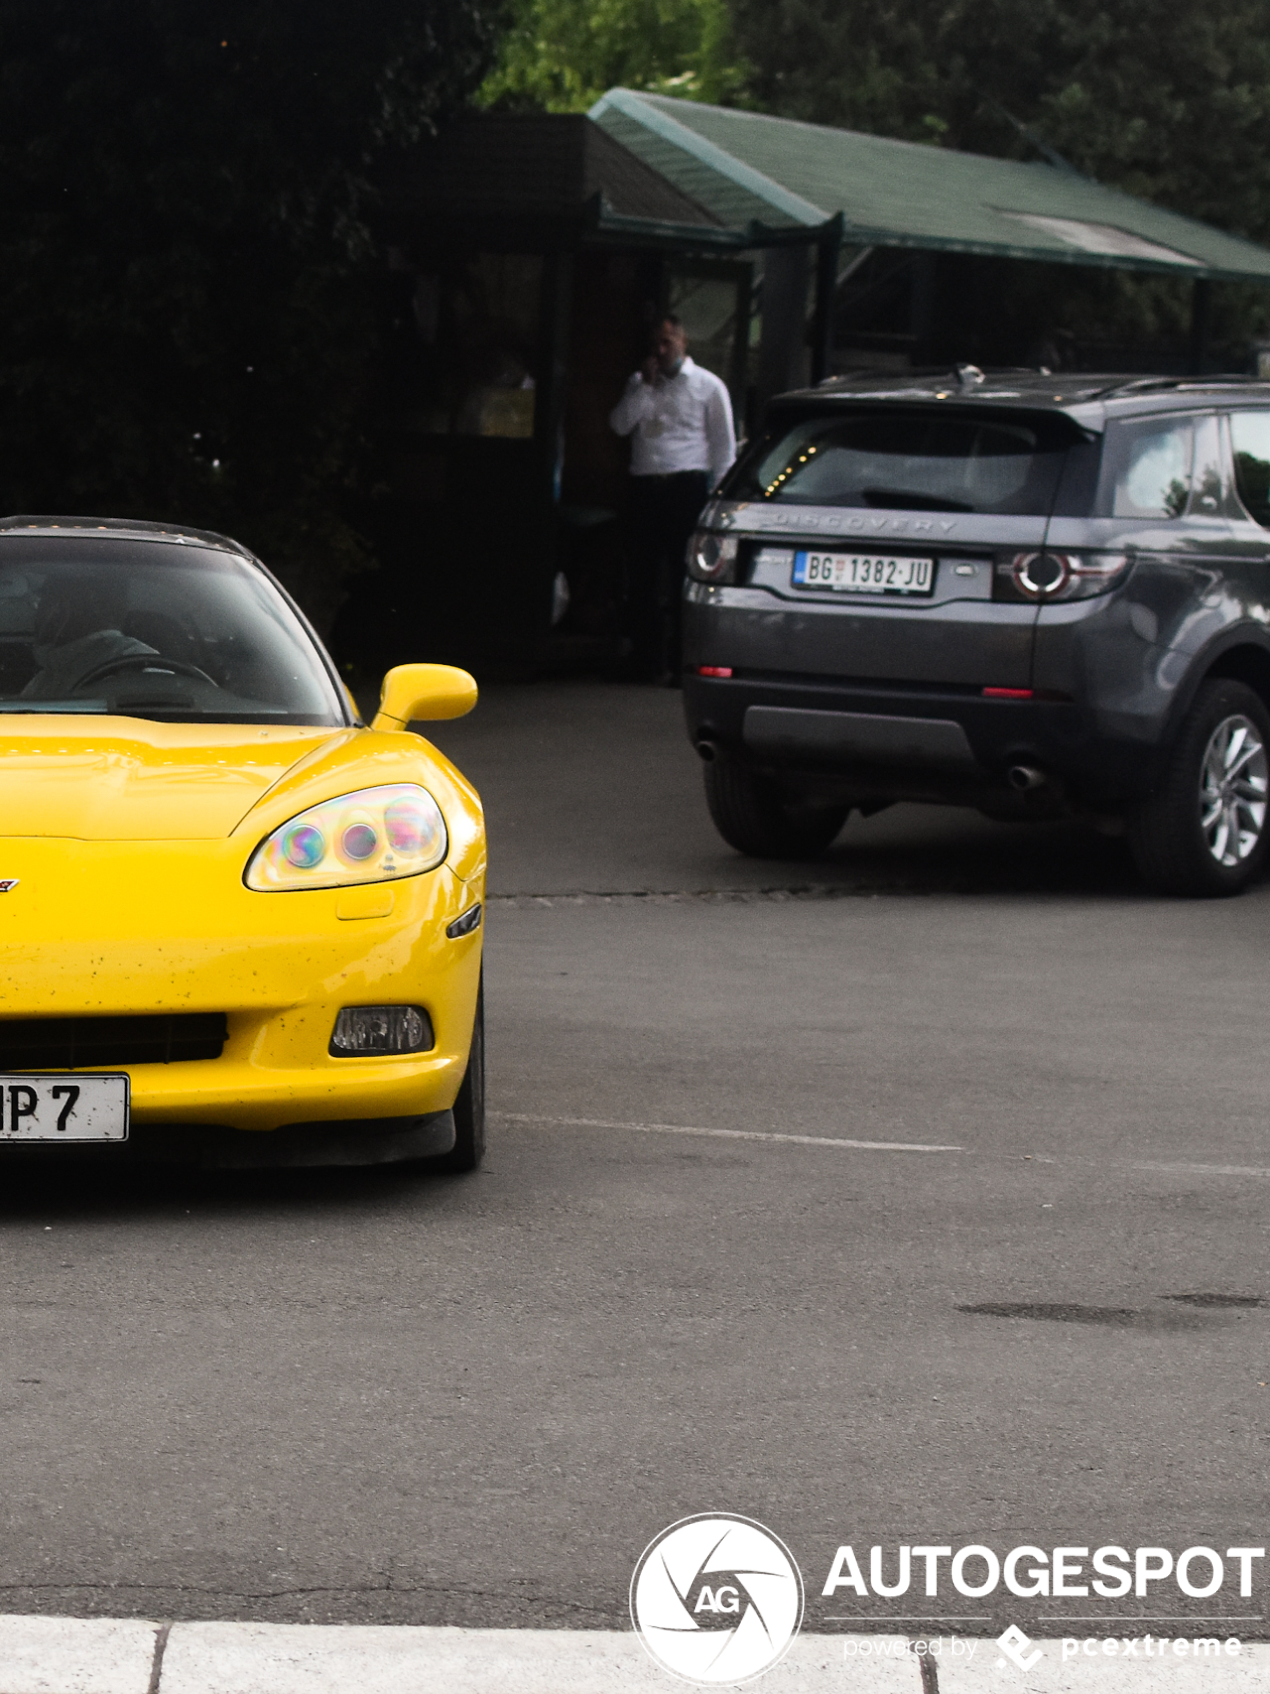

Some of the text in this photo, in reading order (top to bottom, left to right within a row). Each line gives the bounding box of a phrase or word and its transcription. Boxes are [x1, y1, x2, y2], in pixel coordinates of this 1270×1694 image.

[777, 514, 957, 534] DISCOVERY
[809, 555, 833, 580] BG
[51, 1085, 80, 1131] 7
